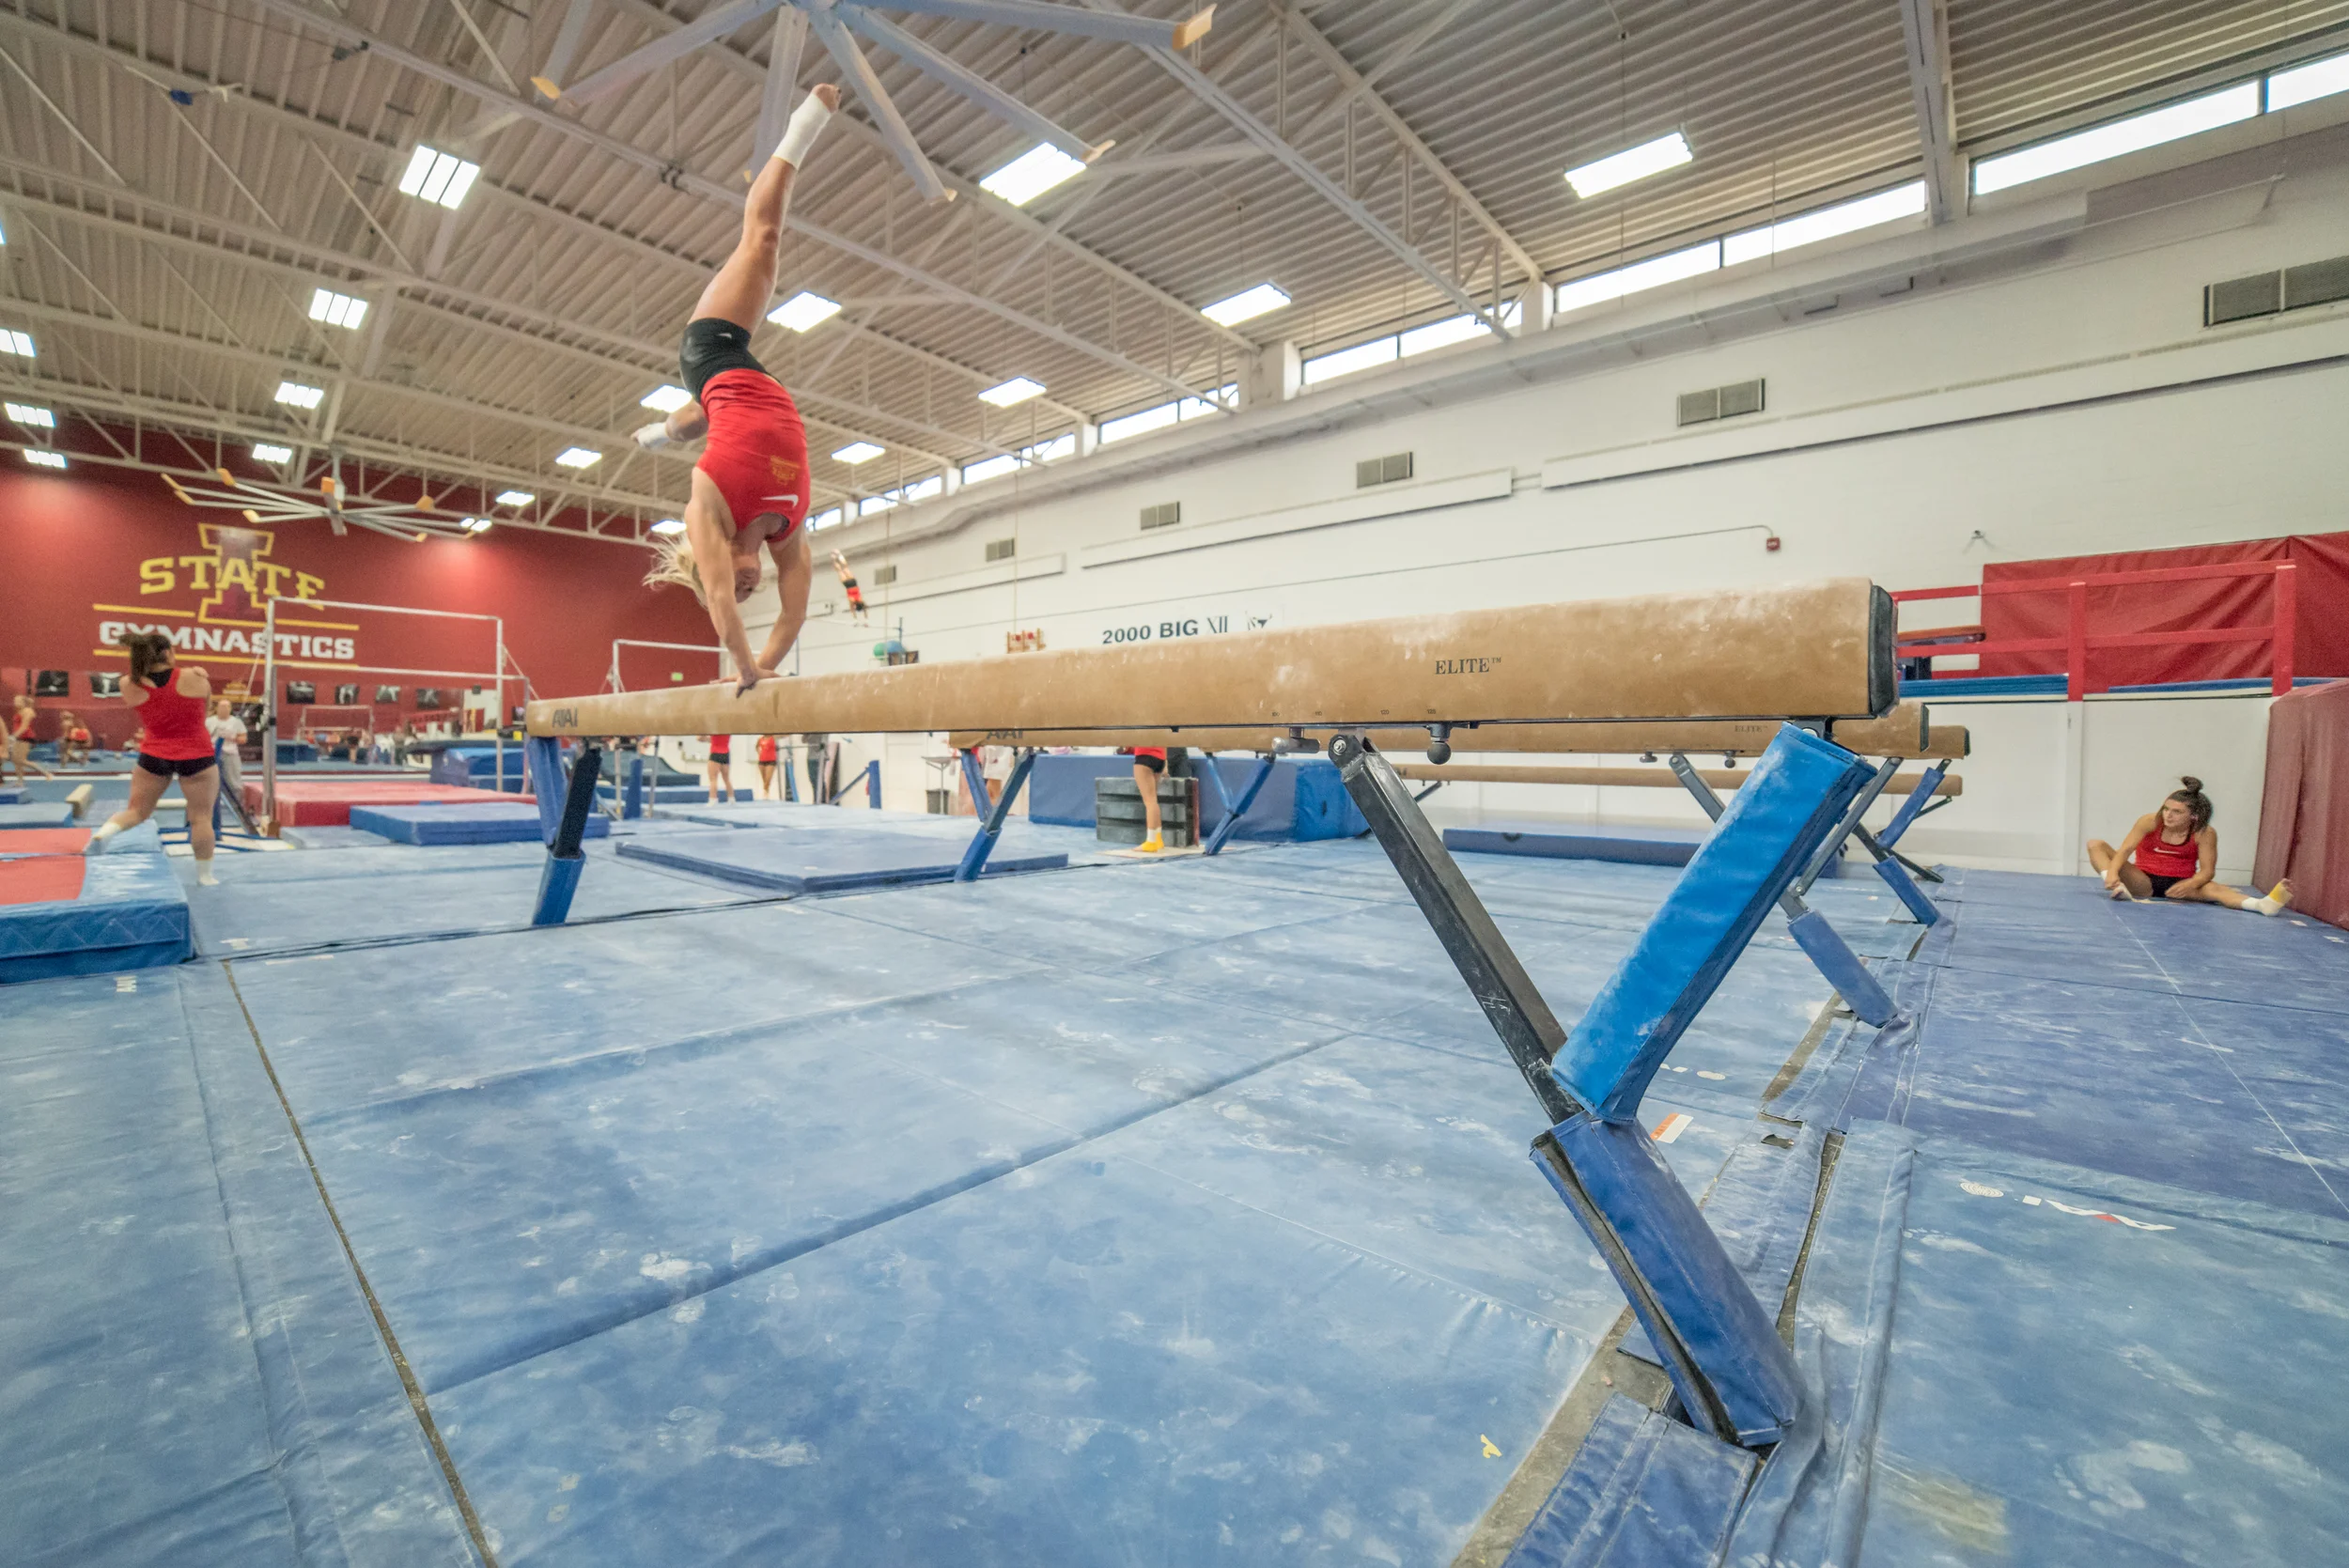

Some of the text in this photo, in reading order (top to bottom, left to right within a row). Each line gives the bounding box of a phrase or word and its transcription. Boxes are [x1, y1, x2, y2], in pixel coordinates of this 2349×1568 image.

[139, 555, 325, 611] STATE
[1102, 625, 1152, 644] 2000
[1159, 619, 1199, 639] BIG
